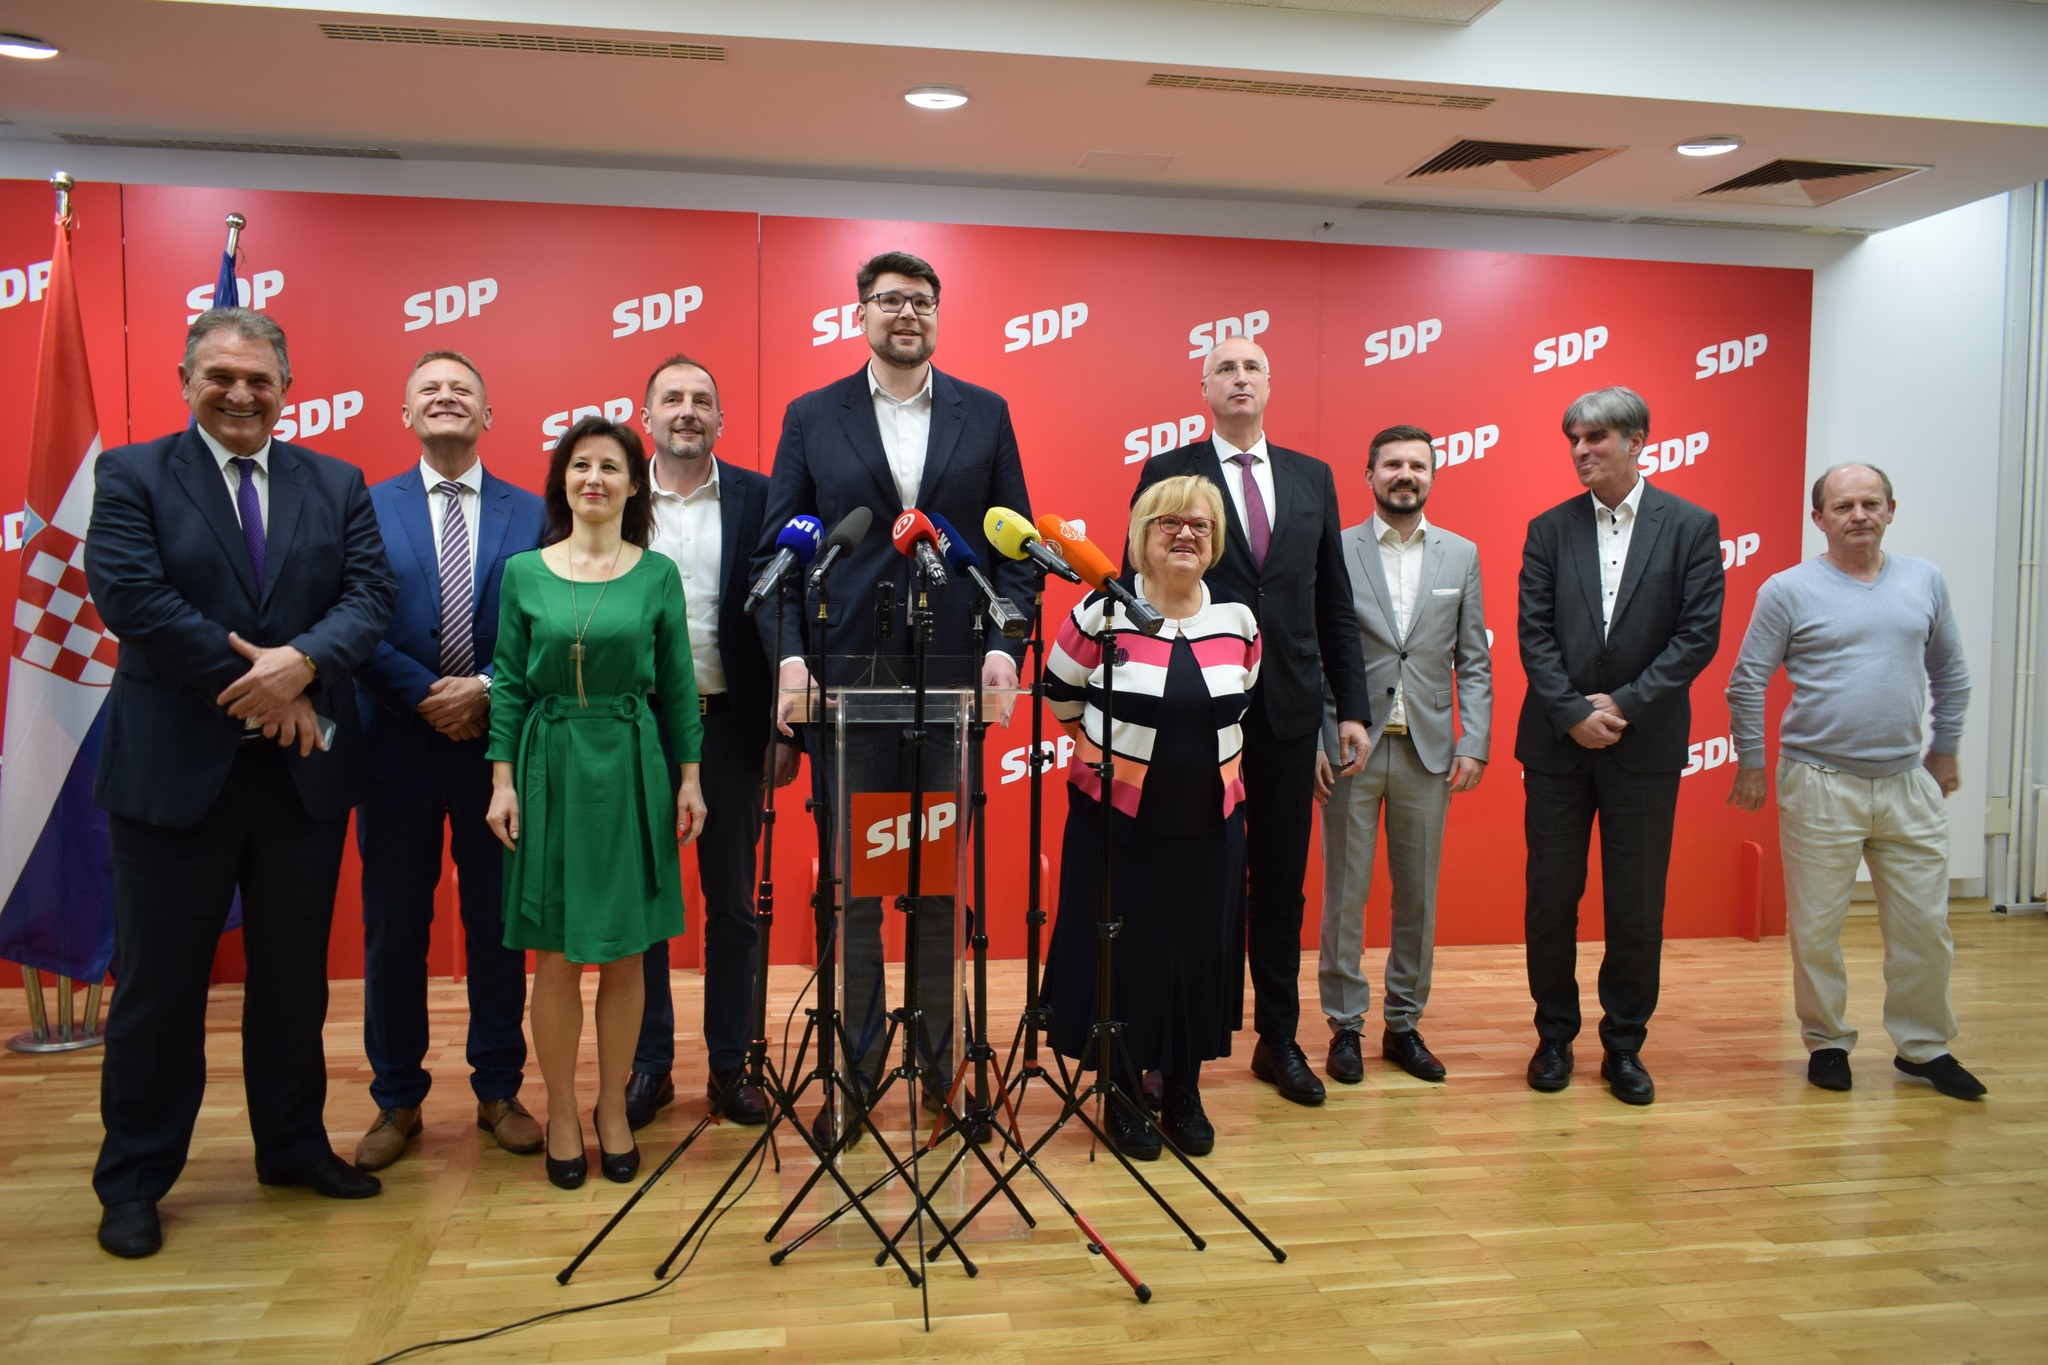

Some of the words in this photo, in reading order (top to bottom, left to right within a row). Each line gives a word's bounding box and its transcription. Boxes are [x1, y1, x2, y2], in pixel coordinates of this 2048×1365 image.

[0, 260, 53, 310] DP
[403, 277, 499, 333] SDP
[612, 285, 704, 339] SDP
[812, 302, 864, 347] SD
[1004, 301, 1089, 354] SDP
[1189, 309, 1270, 360] SDP
[1364, 317, 1443, 367] SDP
[1532, 325, 1609, 374] SDP
[1695, 333, 1768, 381] SDP
[273, 390, 364, 443] SDP
[1124, 414, 1206, 466] SDP
[1638, 431, 1710, 479] SDP
[786, 518, 815, 533] N1
[866, 801, 957, 860] SDP
